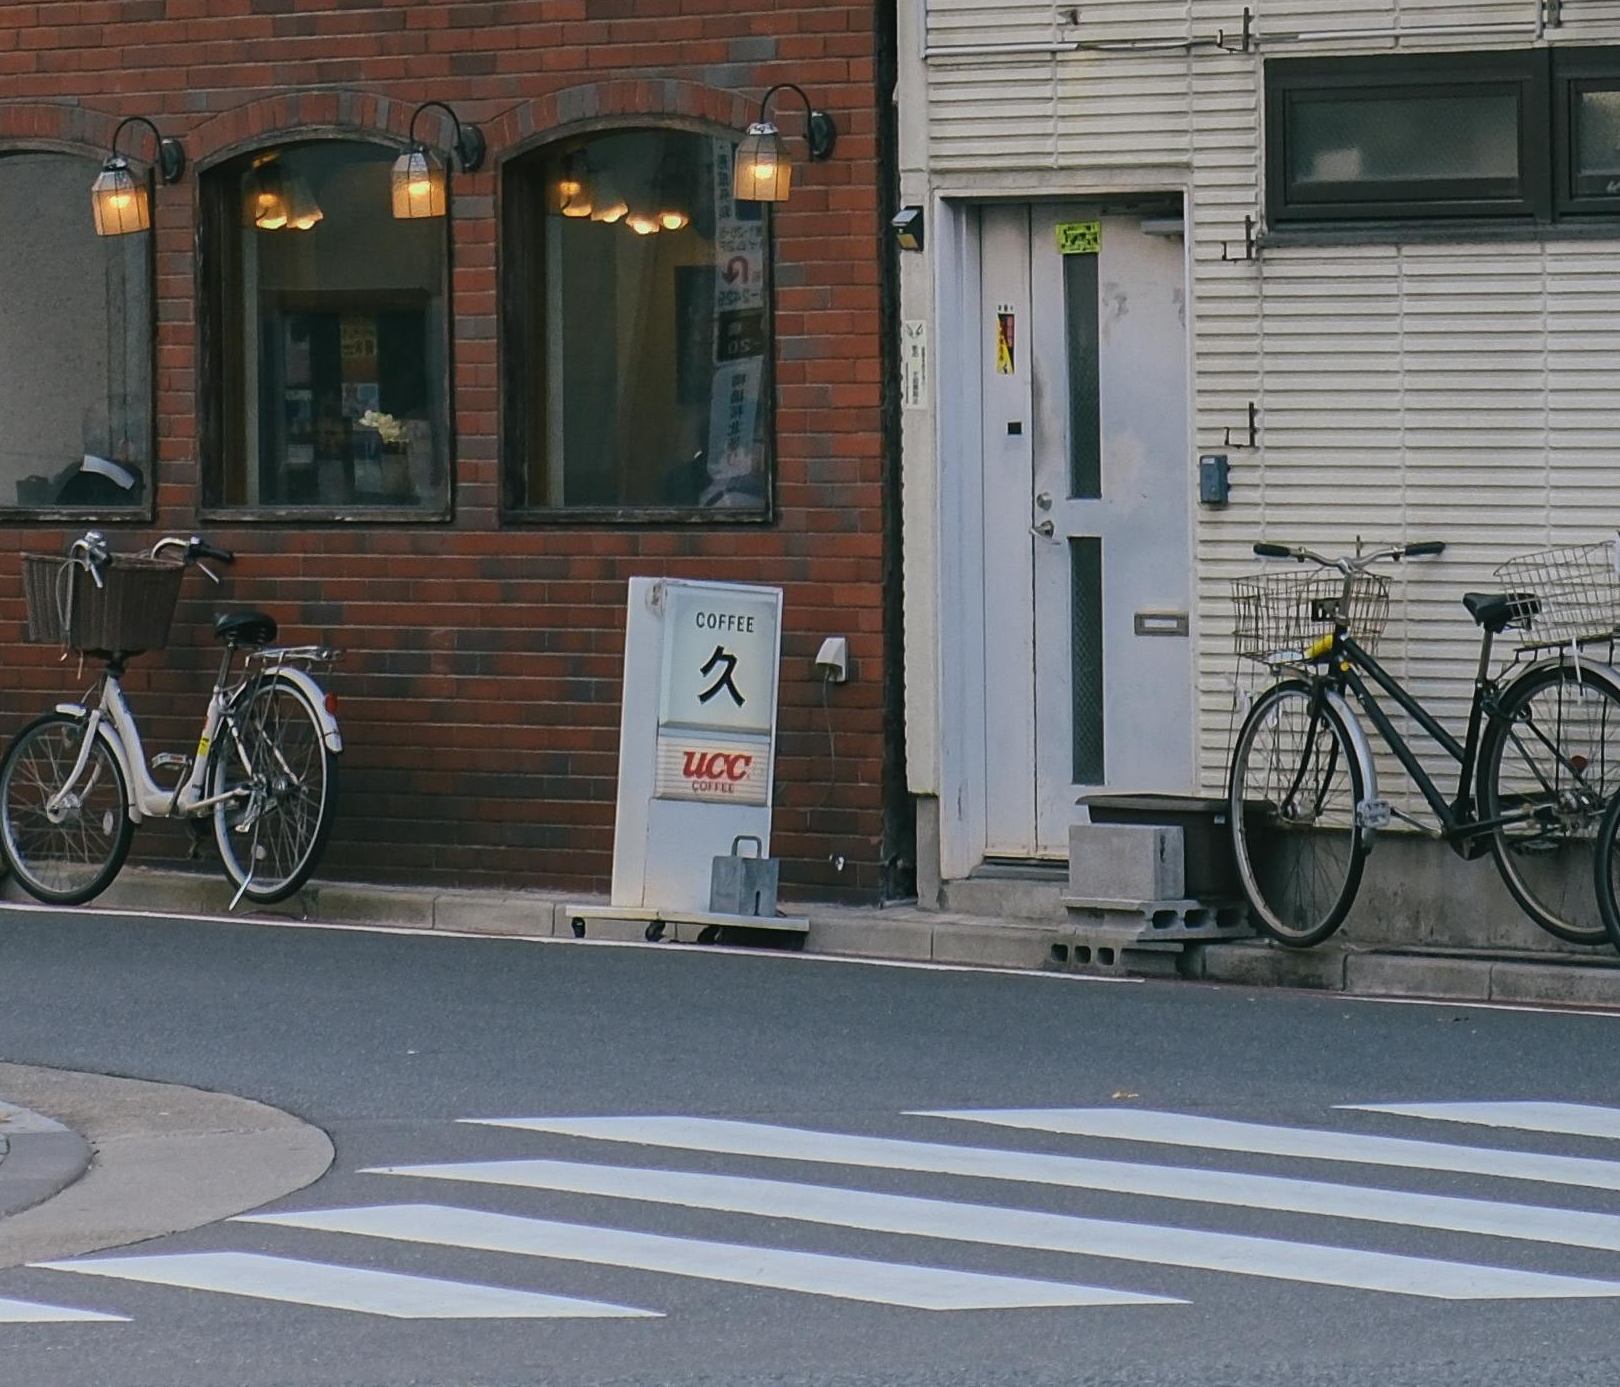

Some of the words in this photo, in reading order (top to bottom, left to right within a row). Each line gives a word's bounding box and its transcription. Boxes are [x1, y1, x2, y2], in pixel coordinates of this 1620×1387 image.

[696, 612, 754, 632] COFFEE
[698, 646, 746, 707] 久
[692, 781, 734, 793] COFFEE
